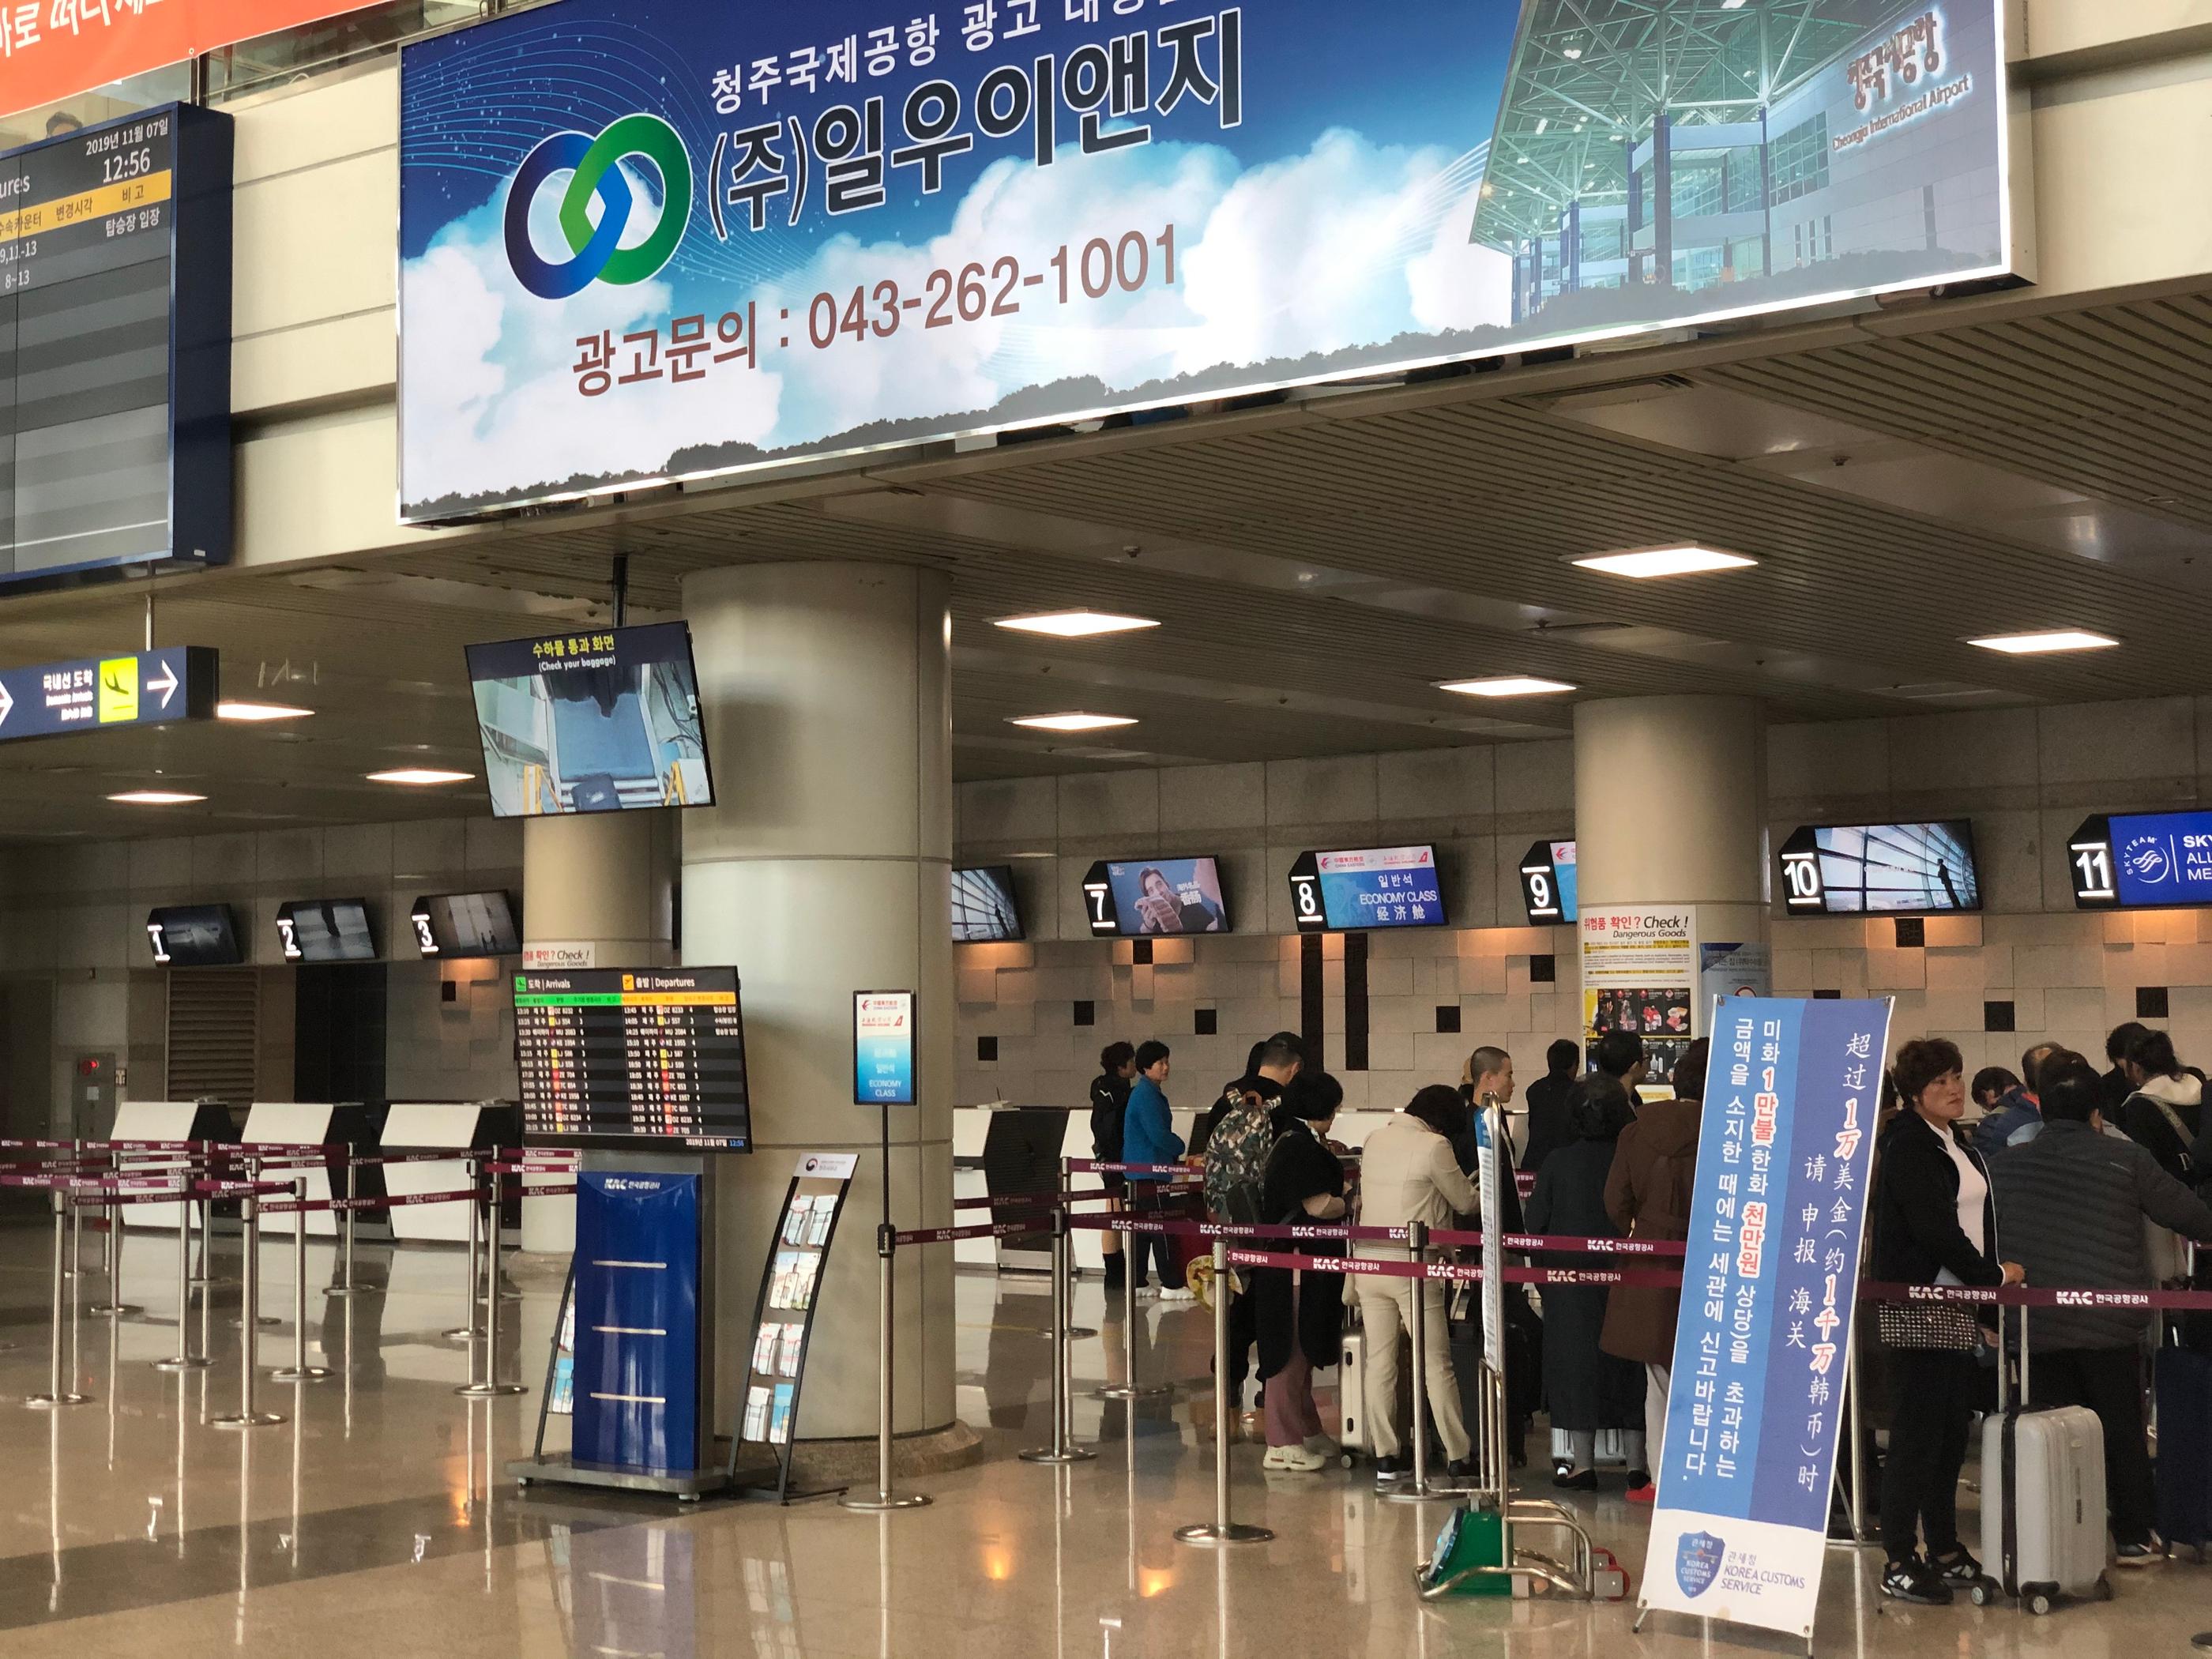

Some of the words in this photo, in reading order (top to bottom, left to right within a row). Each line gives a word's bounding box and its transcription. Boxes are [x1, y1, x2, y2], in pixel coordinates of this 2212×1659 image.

[711, 14, 940, 115] 청주국제공항
[961, 0, 1041, 52] 광고
[1833, 126, 1868, 150] Cheongju
[1870, 94, 1927, 135] International
[1929, 75, 1969, 107] Airport
[708, 7, 1243, 242] (주)일우이앤지
[86, 130, 119, 156] 2019년
[122, 123, 144, 146] 11월
[147, 118, 169, 138] 07일
[103, 147, 151, 183] 12:56
[0, 175, 30, 198] ures
[56, 198, 93, 221] 변경시각
[106, 213, 137, 237] 탑승장
[140, 207, 160, 229] 입장
[5, 269, 30, 289] 8~13
[572, 303, 757, 398] 광고문의
[808, 223, 1177, 352] 043-262-1001
[532, 639, 565, 659] 수하물
[568, 636, 589, 656] 통과
[592, 634, 615, 652] 화면
[538, 659, 562, 673] (Check
[563, 659, 581, 671] your
[581, 655, 616, 669] baggage)
[2124, 835, 2157, 876] SKYTEAM
[1784, 860, 1817, 897] 10
[2075, 850, 2110, 890] 11
[2188, 867, 2212, 881] ME
[1298, 882, 1317, 915] 8
[1360, 891, 1406, 905] ECONOMY
[1407, 890, 1438, 902] CLASS
[1529, 873, 1550, 908] 9
[1090, 890, 1104, 921] 7
[1584, 916, 1607, 931] 위험품
[1610, 916, 1631, 930] 확인
[1644, 915, 1680, 929] Check
[282, 926, 295, 950] 2
[420, 920, 433, 946] 3
[1612, 930, 1656, 940] Dangerous
[1658, 928, 1687, 938] Goods
[152, 931, 164, 955] 1
[557, 950, 583, 961] Check
[546, 978, 571, 989] Arrivals
[656, 977, 696, 989] Departures
[1729, 1018, 1755, 1086] 금액을
[1722, 1094, 1746, 1164] 소지한
[221, 1181, 235, 1190] KAC
[604, 1178, 628, 1191] KAC
[329, 1199, 348, 1209] KAC
[406, 1194, 424, 1205] KAC
[1712, 1172, 1739, 1243] 때에는
[936, 1229, 951, 1240] KAC
[993, 1224, 1007, 1235] KAC
[1112, 1220, 1133, 1230] KAC
[1134, 1223, 1164, 1232] 한국공항공사
[1200, 1224, 1222, 1236] KAC
[1292, 1226, 1315, 1238] KAC
[1315, 1228, 1349, 1236] 한국공항공사
[1389, 1228, 1409, 1240] KA
[1507, 1237, 1544, 1247] 한국공항공사
[1587, 1240, 1614, 1251] KAC
[1616, 1243, 1653, 1252] 한국공항공사
[1232, 1252, 1269, 1264] 한국공항공사
[1312, 1258, 1340, 1270] KAC
[1341, 1261, 1380, 1271] 한국공항공사
[1427, 1265, 1455, 1278] KAC
[1547, 1270, 1577, 1283] KAC
[1578, 1273, 1622, 1282] 한국공항공사
[1703, 1251, 1730, 1323] 세관에
[1909, 1285, 1944, 1300] KAC
[1947, 1288, 1997, 1300] 한국공항공사
[2056, 1290, 2094, 1306] KAC
[2096, 1292, 2149, 1304] 한국공항공사
[1682, 1332, 1721, 1482] 신고바랍니다.
[1715, 1381, 1745, 1480] 초과하는
[1680, 1567, 1711, 1579] CUSTOMS
[1686, 1559, 1710, 1569] KOREA
[1683, 1576, 1705, 1586] SERVICE
[1724, 1566, 1759, 1582] KOREA
[1761, 1571, 1806, 1589] CUSTOMS
[1721, 1578, 1763, 1596] SERVICE
